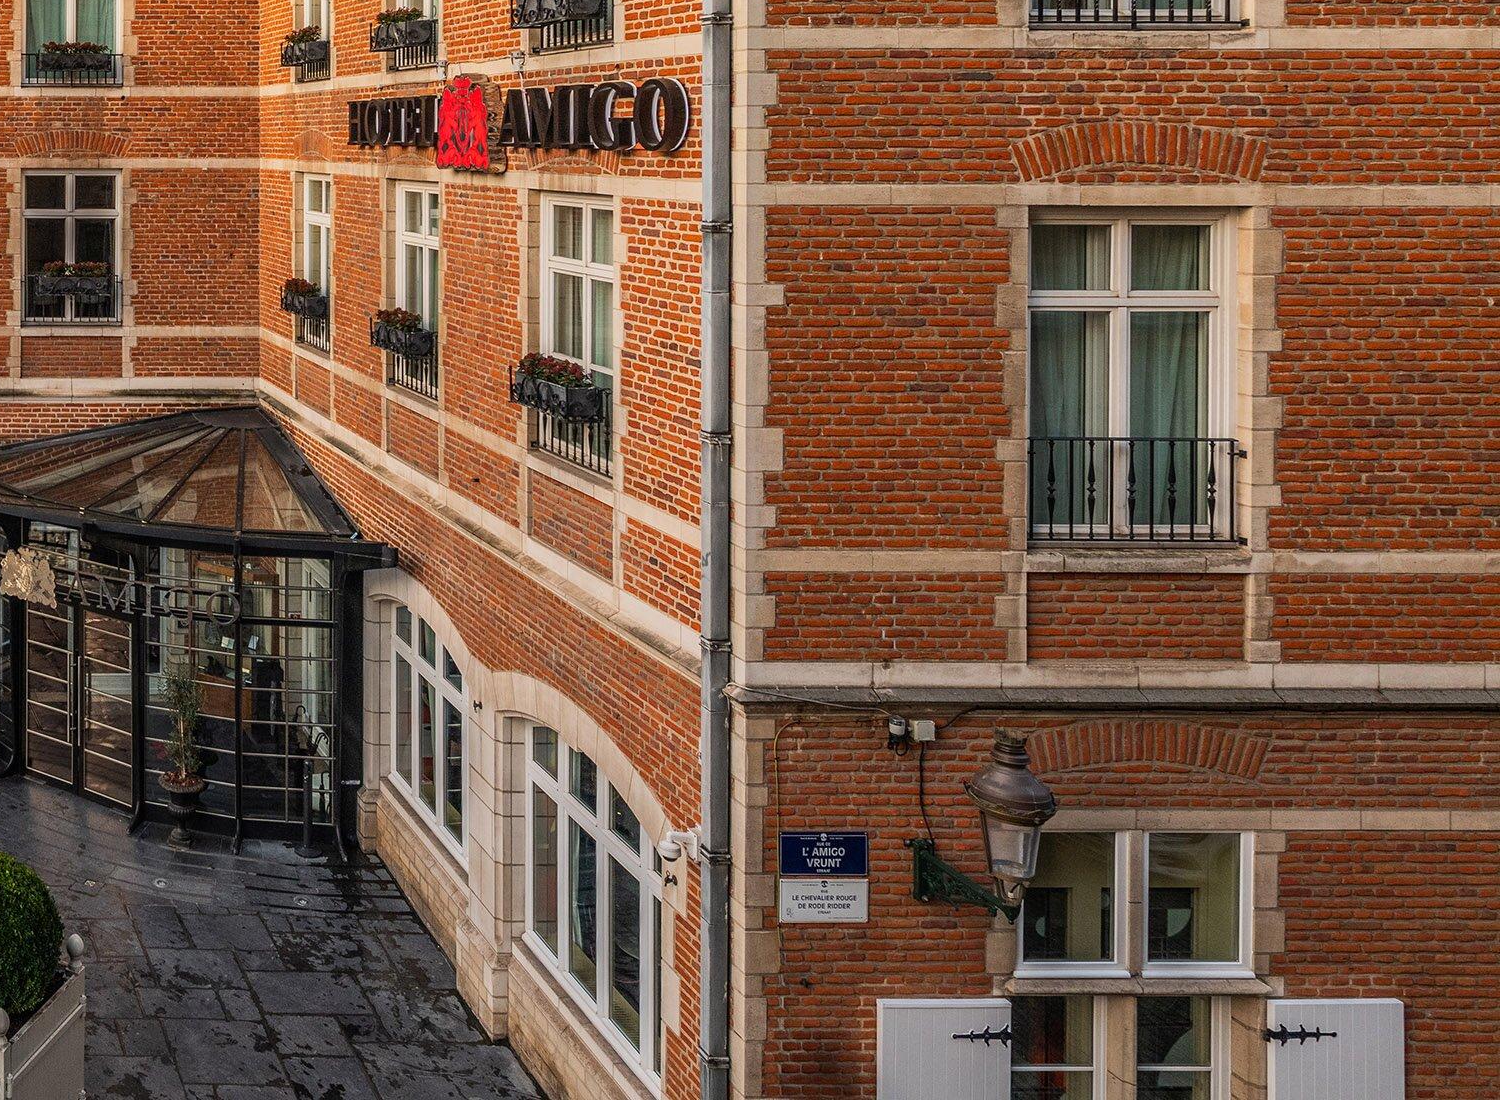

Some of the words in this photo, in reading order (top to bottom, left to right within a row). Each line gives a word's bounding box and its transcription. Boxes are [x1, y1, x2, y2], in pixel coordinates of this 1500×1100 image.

[347, 95, 438, 149] HOTEL
[501, 77, 690, 151] AMIGO
[63, 571, 241, 625] AMIGO
[802, 847, 809, 856] L'
[812, 847, 845, 856] AMIGO
[806, 858, 842, 868] VRUNT
